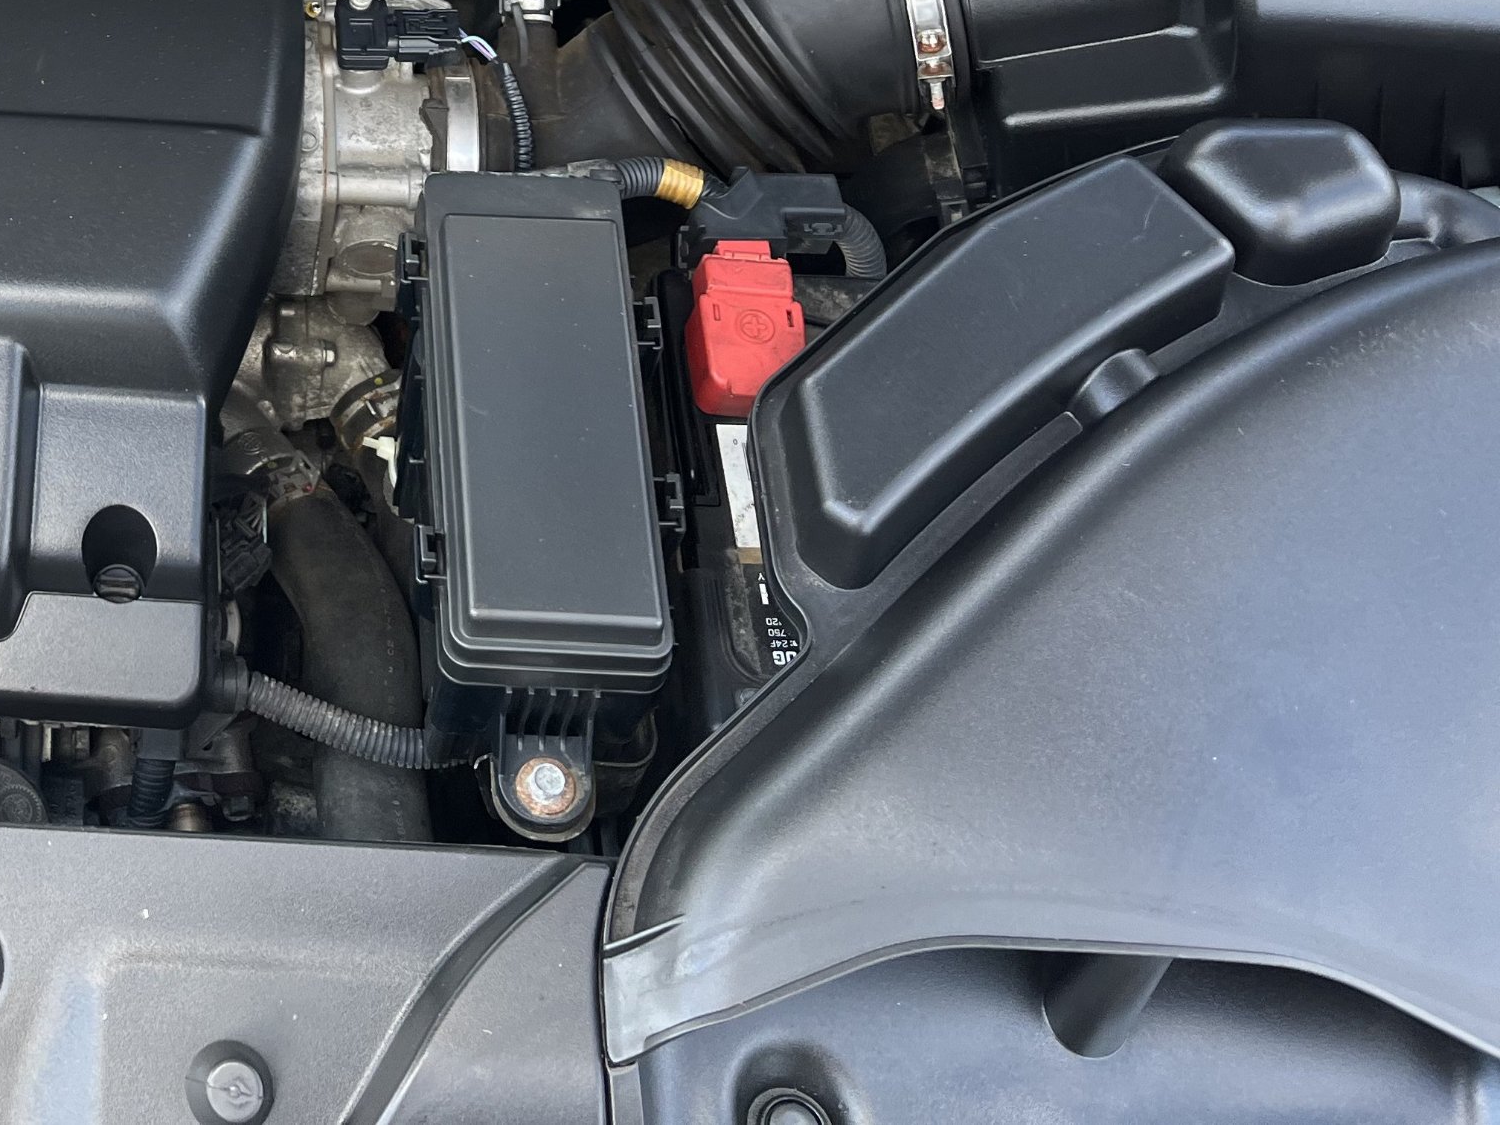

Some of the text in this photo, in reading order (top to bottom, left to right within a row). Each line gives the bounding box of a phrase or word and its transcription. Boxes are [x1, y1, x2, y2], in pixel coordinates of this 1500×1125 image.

[765, 618, 782, 626] 20
[767, 628, 786, 637] 750
[770, 639, 789, 648] 24F
